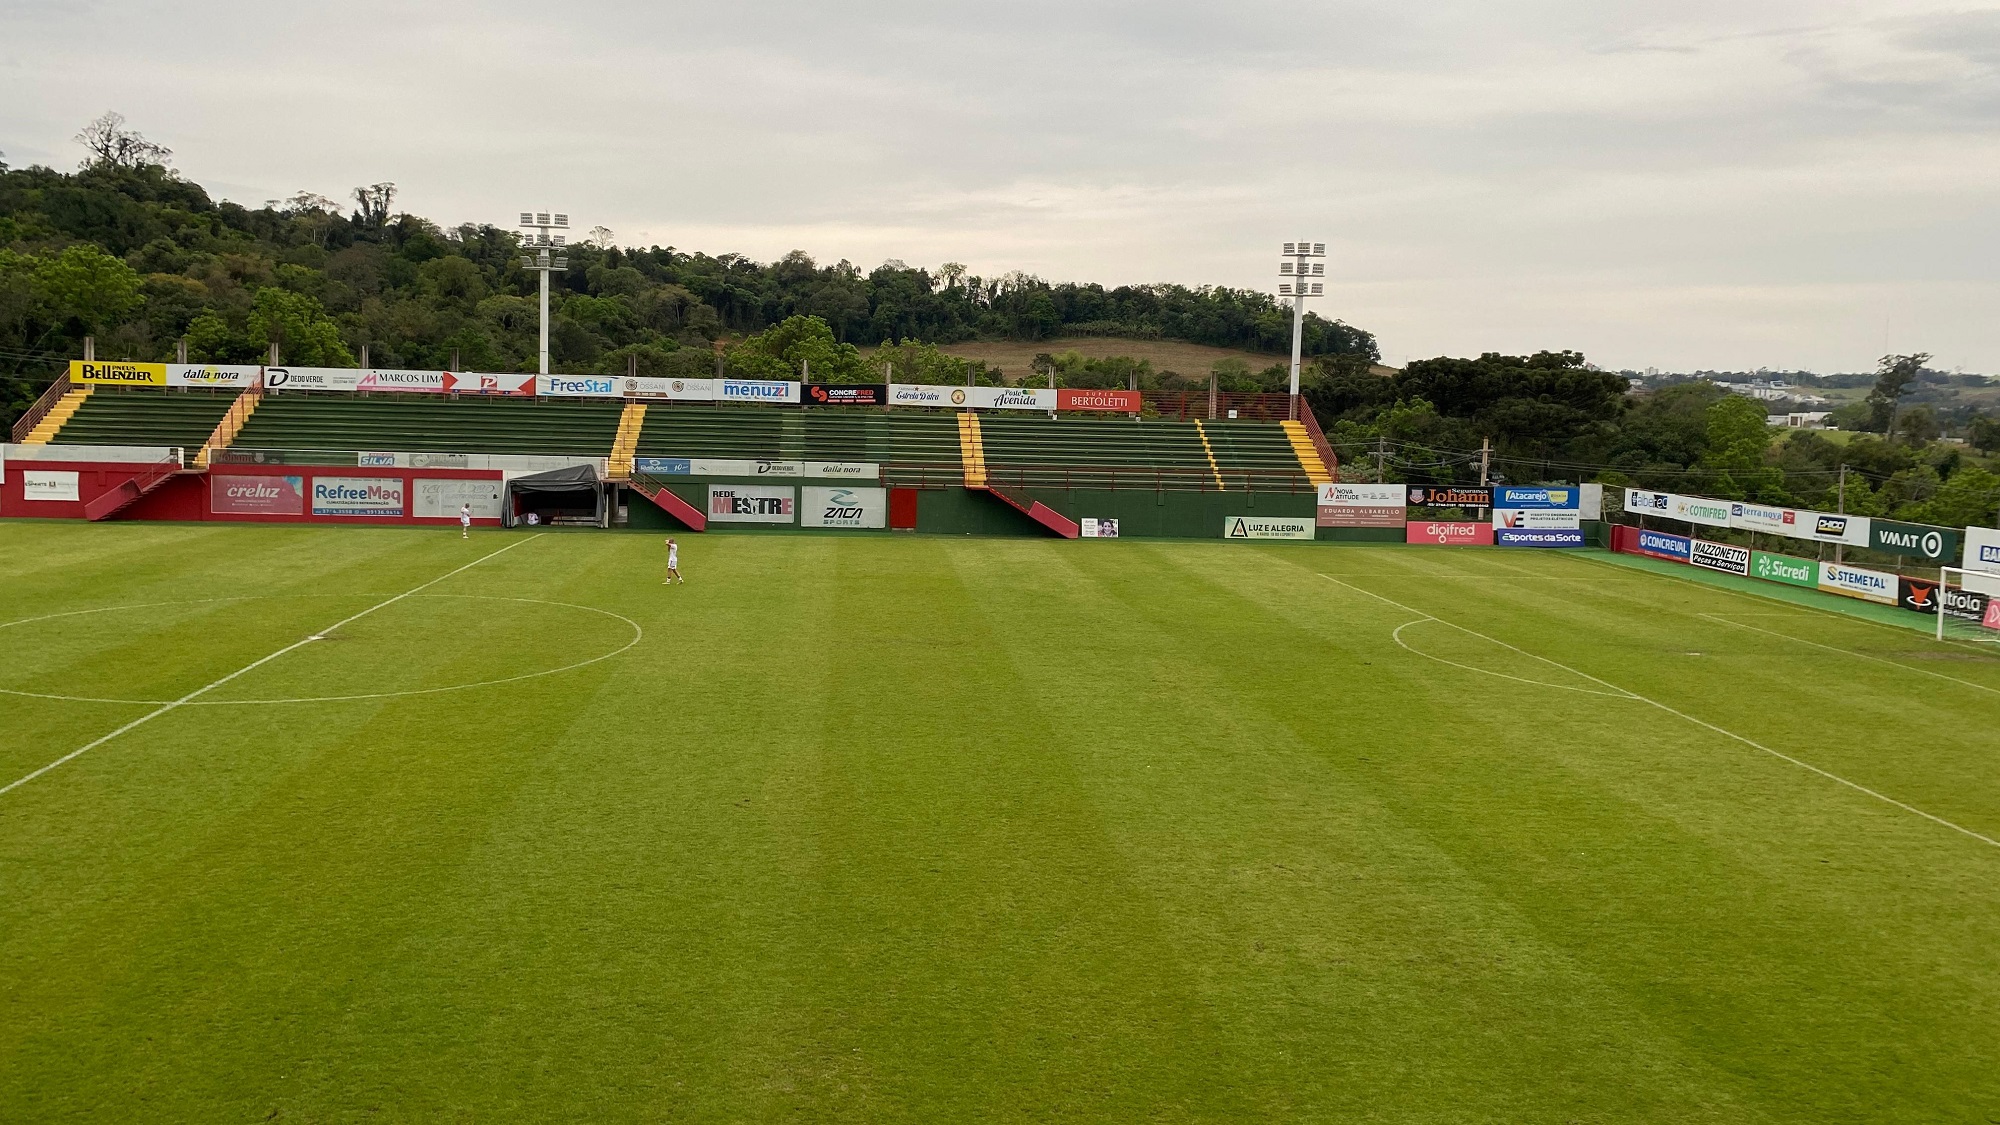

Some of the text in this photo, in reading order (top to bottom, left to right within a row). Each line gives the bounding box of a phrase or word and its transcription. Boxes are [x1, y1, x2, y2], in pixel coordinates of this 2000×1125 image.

[184, 369, 239, 380] dalla nora
[379, 374, 419, 382] MARCOS
[422, 374, 444, 382] LIMA
[550, 378, 612, 392] FreeStal
[994, 394, 1036, 407] Avenida
[1072, 396, 1128, 406] BERTOLETTI
[362, 456, 394, 464] SILVA
[227, 484, 280, 498] creluz
[316, 484, 400, 504] RefreeMaq
[1427, 489, 1489, 503] Johann
[1510, 492, 1546, 501] Atacarejo
[712, 498, 792, 514] MESTRE
[1690, 505, 1727, 520] COTRIFRED
[1744, 508, 1761, 516] terra
[1762, 512, 1782, 520] nova
[1427, 524, 1475, 543] digifred
[1502, 534, 1543, 542] Esportes
[1556, 532, 1581, 542] Sorte
[1880, 530, 1919, 548] VMAT
[1647, 536, 1688, 554] CONCREVAL
[1694, 542, 1747, 562] MAZZONETTO
[1982, 547, 2000, 562] BA
[1694, 555, 1710, 564] Peças
[1716, 560, 1744, 571] Serviços
[1772, 560, 1810, 582] Sicredi
[1838, 571, 1886, 589] STEMETAL
